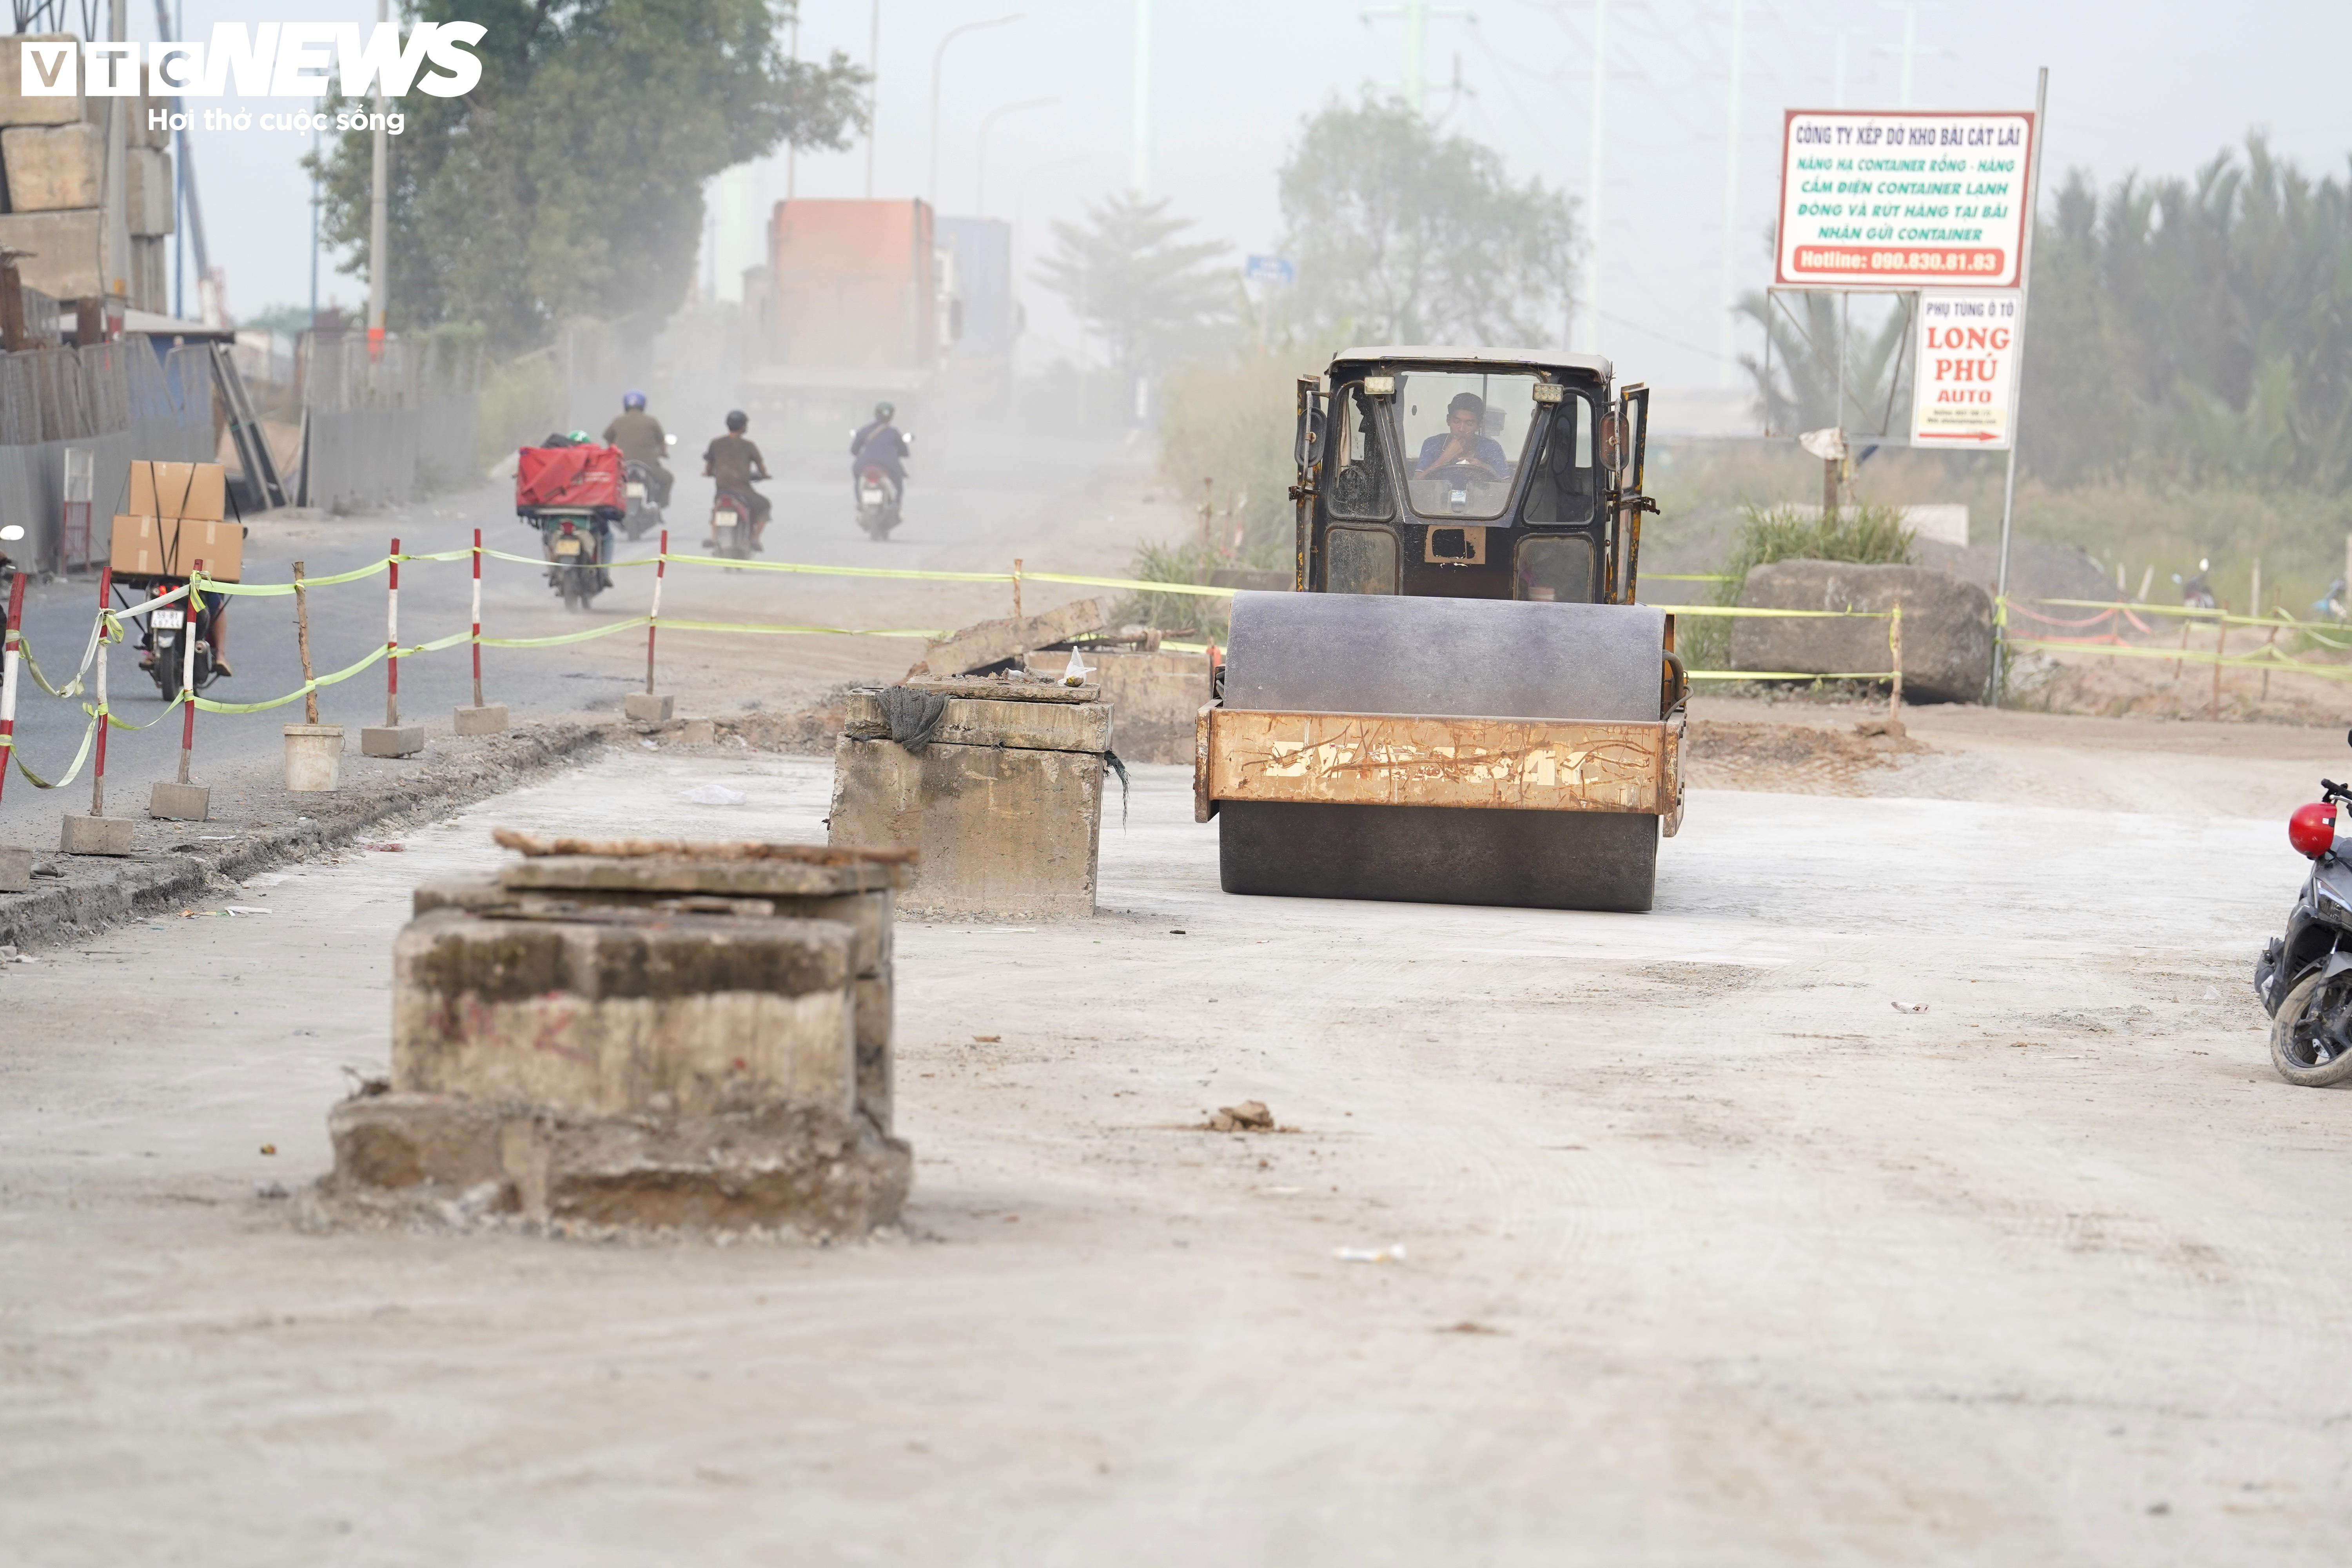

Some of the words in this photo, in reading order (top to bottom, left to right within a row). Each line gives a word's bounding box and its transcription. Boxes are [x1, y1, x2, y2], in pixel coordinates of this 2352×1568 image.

[1797, 122, 1831, 144] CÔNG
[1837, 127, 1852, 144] TY
[1909, 127, 1936, 145] KHO
[1837, 158, 1853, 174] HẠ
[1858, 159, 1926, 171] CONTAINER
[1877, 182, 1961, 194] CONTAINER
[1898, 227, 1982, 241] CONTAINER
[1800, 250, 1868, 269] Hotline:
[1927, 327, 2010, 349] LONG
[1935, 353, 1998, 381] PHÚ
[1938, 390, 1991, 402] AUTO
